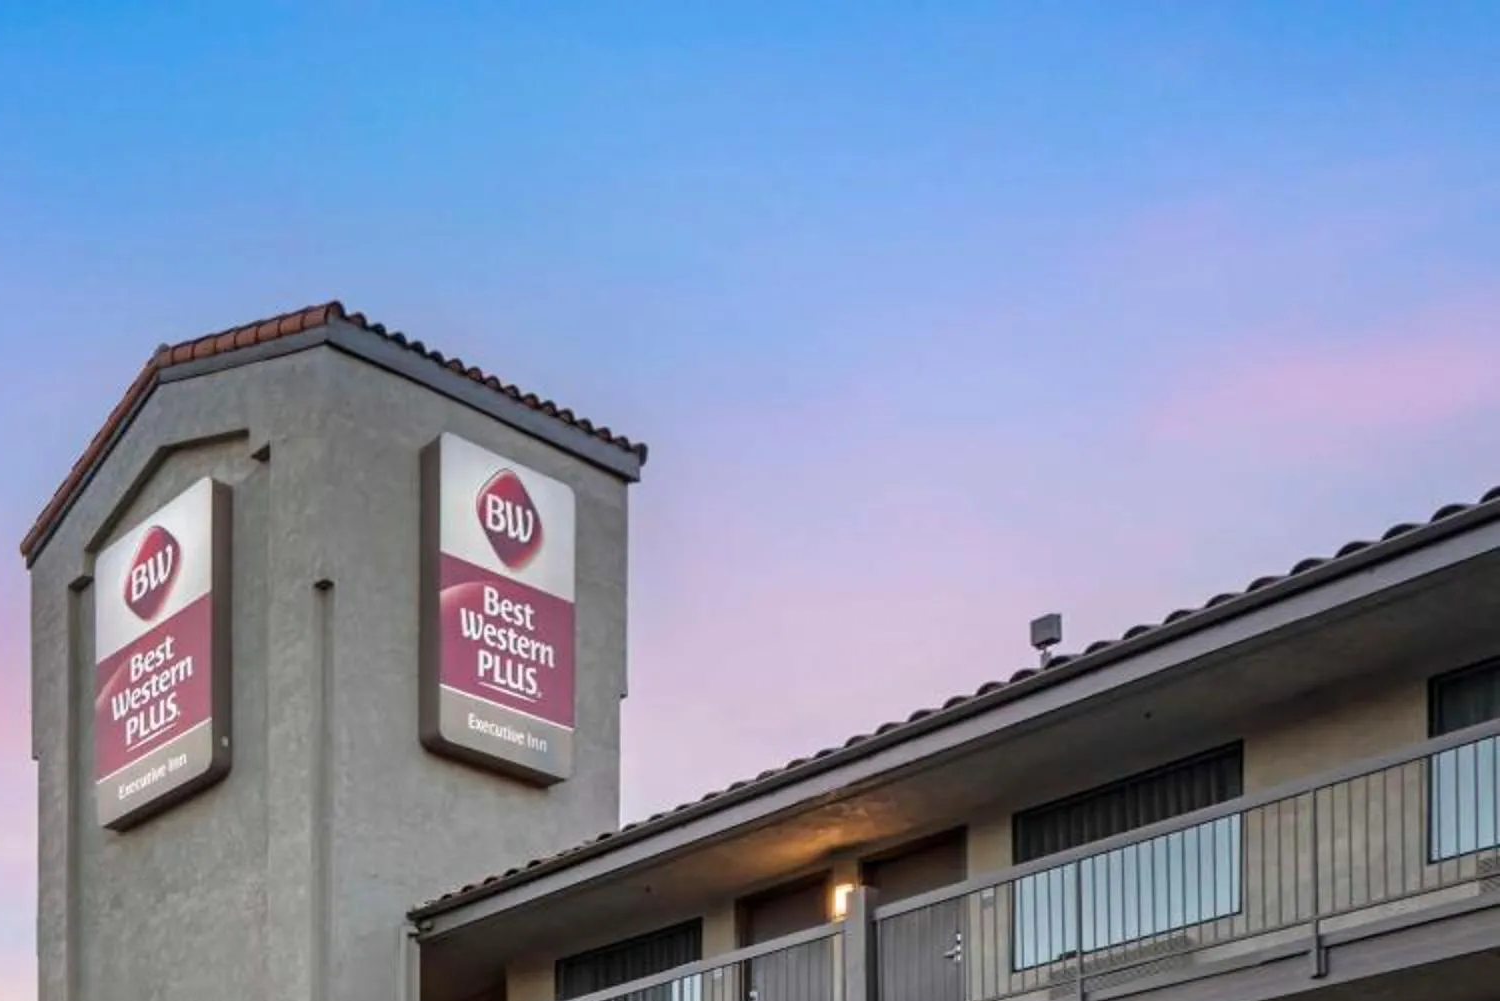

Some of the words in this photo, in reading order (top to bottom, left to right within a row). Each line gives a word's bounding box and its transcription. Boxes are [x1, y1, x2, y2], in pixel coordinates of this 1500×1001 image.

[484, 493, 534, 544] BW
[130, 543, 173, 602] BW
[483, 584, 535, 631] Best
[129, 634, 176, 683] Best
[459, 607, 556, 668] Western
[111, 656, 194, 721] Western
[477, 649, 538, 696] PLUS
[125, 692, 179, 746] PLUS
[467, 712, 526, 746] Executive
[527, 732, 548, 753] Inn
[118, 760, 168, 801] Executive
[167, 752, 188, 775] Inn
